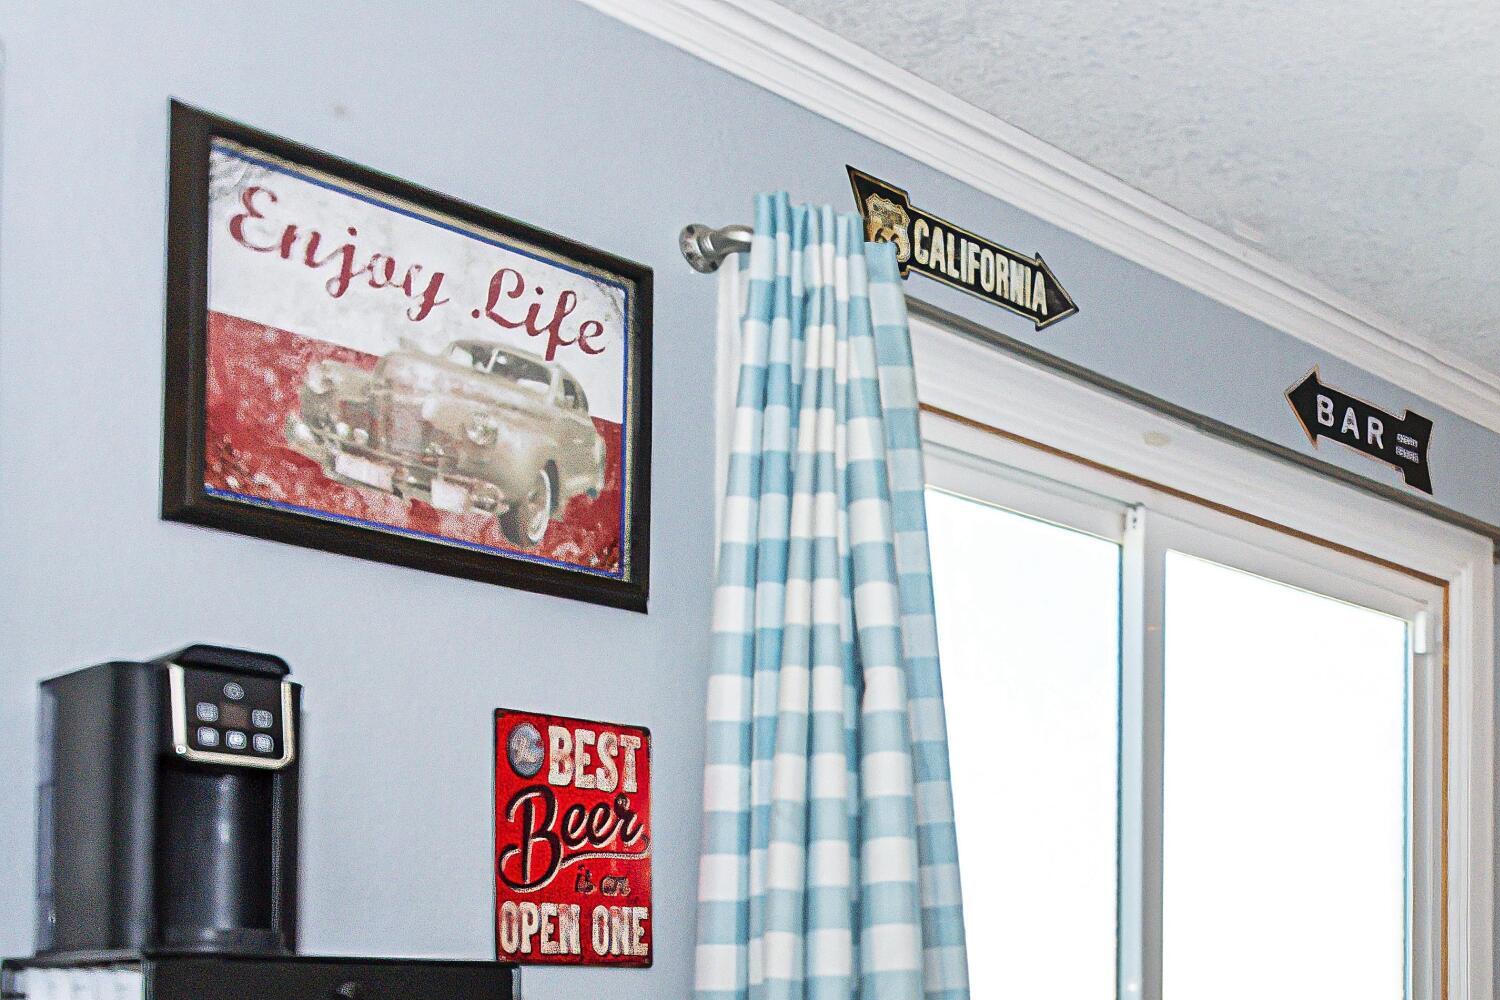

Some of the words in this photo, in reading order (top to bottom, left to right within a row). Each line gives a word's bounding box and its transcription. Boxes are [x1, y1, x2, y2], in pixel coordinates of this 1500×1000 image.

[228, 185, 450, 321] Enjoy
[471, 268, 606, 361] Life
[913, 218, 1048, 316] CALIFORNIA
[1316, 394, 1384, 449] BAR
[547, 725, 642, 793] BEST
[499, 785, 650, 893] Beer
[500, 901, 581, 955] OPEN
[592, 904, 649, 957] ONE
